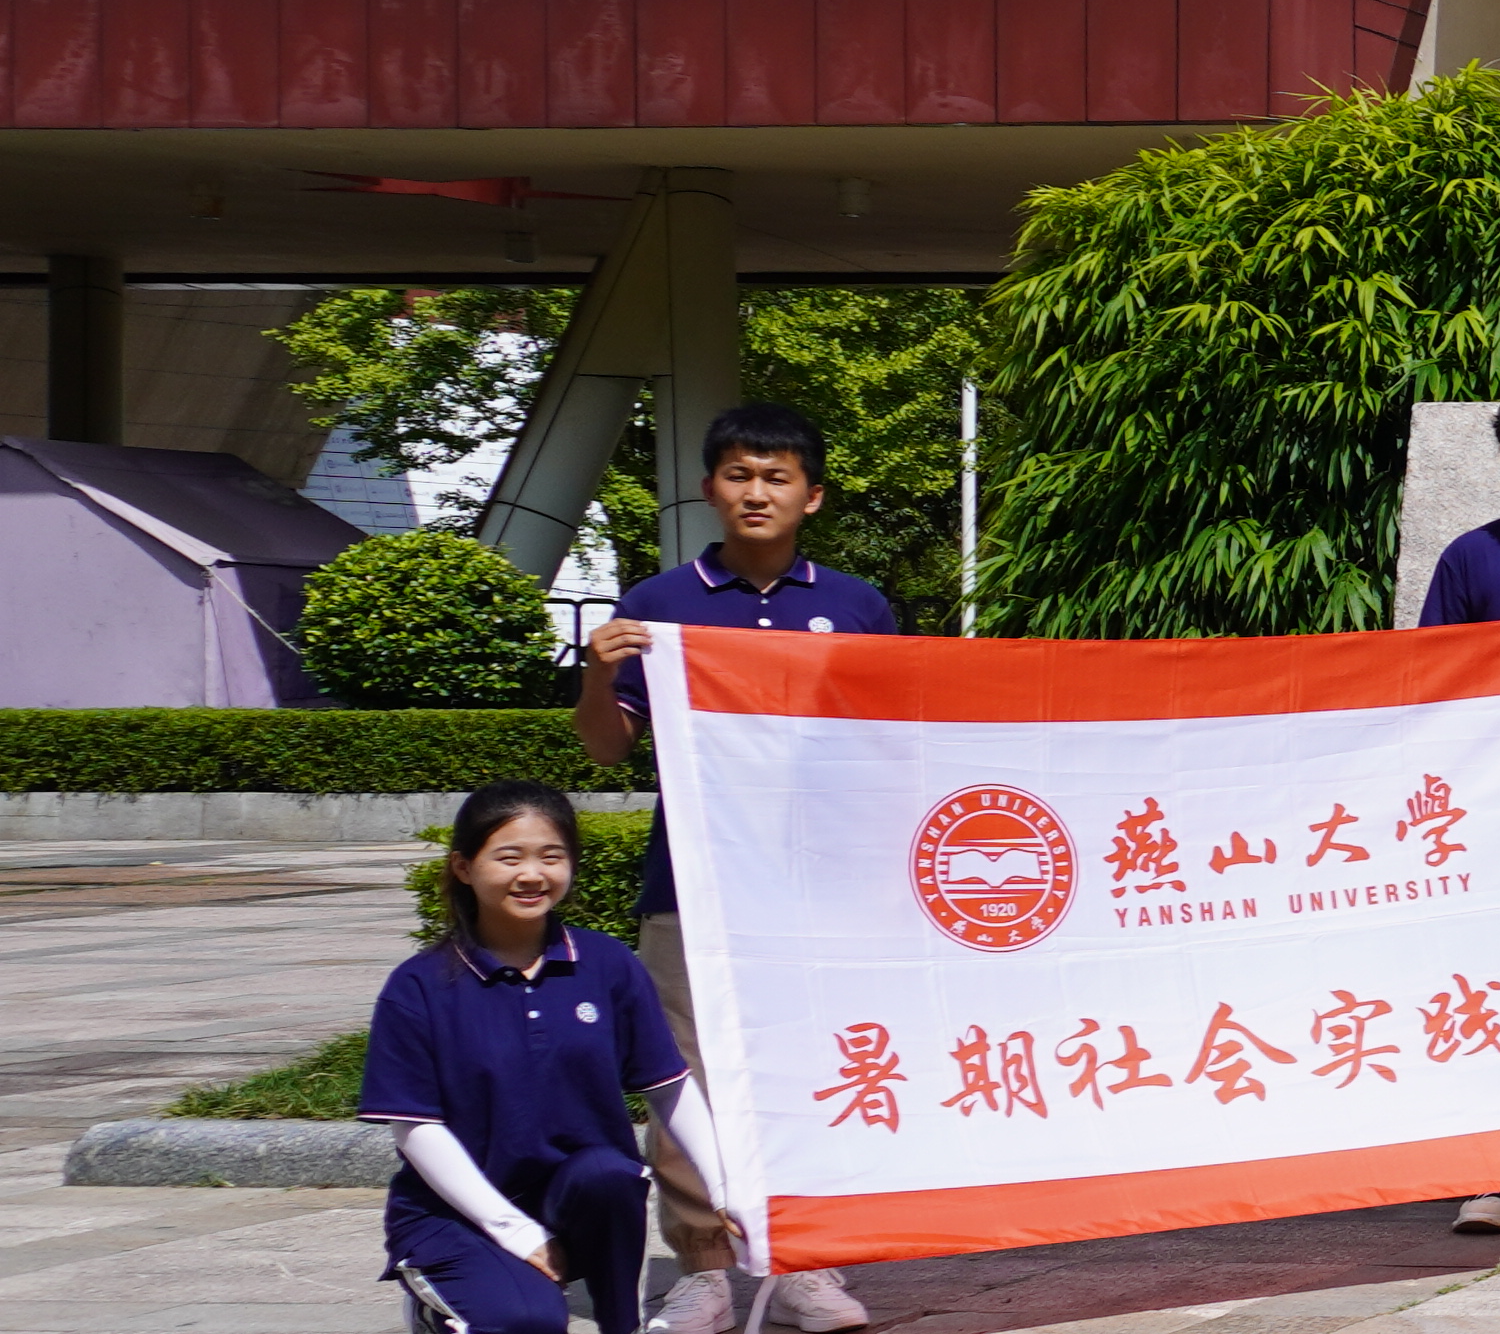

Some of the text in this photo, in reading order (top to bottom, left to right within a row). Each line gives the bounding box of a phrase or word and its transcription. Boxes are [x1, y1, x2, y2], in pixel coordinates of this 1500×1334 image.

[918, 793, 1069, 903] YANSHAN UNIVERSITY
[979, 902, 1018, 917] 1920
[1115, 873, 1472, 929] YANSHAN UNIVERSITY
